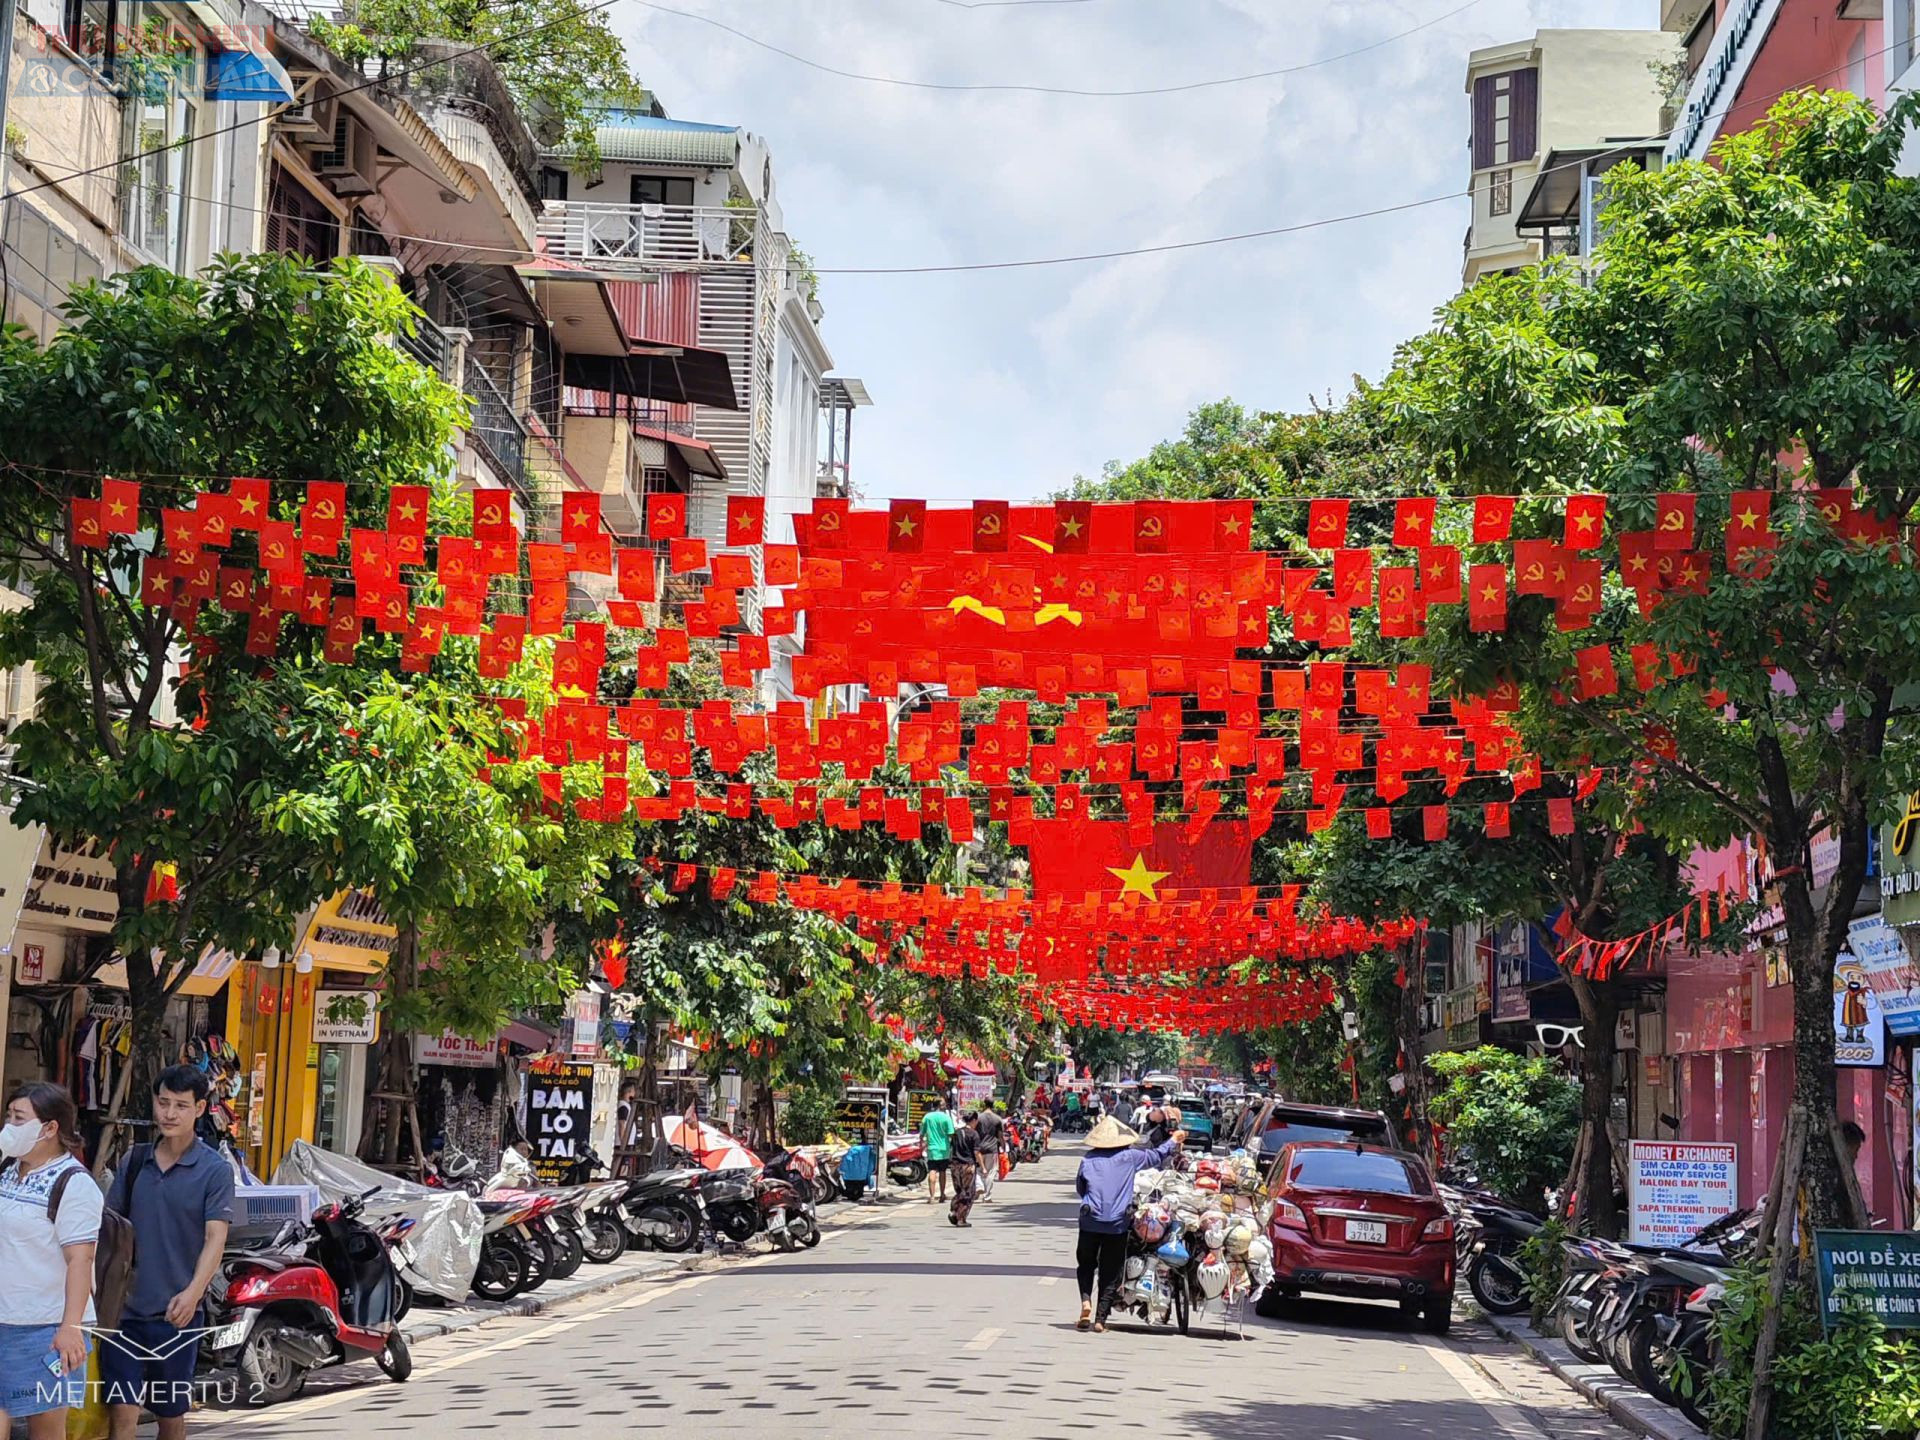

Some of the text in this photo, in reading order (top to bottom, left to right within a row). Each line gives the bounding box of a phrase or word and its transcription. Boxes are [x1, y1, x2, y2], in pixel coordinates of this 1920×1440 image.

[838, 1121, 875, 1129] MASSAGE
[538, 1138, 575, 1157] TAI
[1634, 1145, 1733, 1162] MONEY EXCHANGE
[1641, 1161, 1658, 1169] SIM
[1661, 1162, 1689, 1170] CARD
[1641, 1170, 1727, 1179] LAUNDRY SERVICE
[1639, 1179, 1678, 1187] HALONG
[1637, 1204, 1729, 1214] SAPA TREKKING TOUR
[1639, 1224, 1651, 1232] HA
[1653, 1225, 1679, 1233] GIANG
[1349, 1231, 1382, 1242] 371.42
[1831, 1243, 1920, 1266] NƠI ĐỂ XE
[1889, 1294, 1915, 1313] CÔNG
